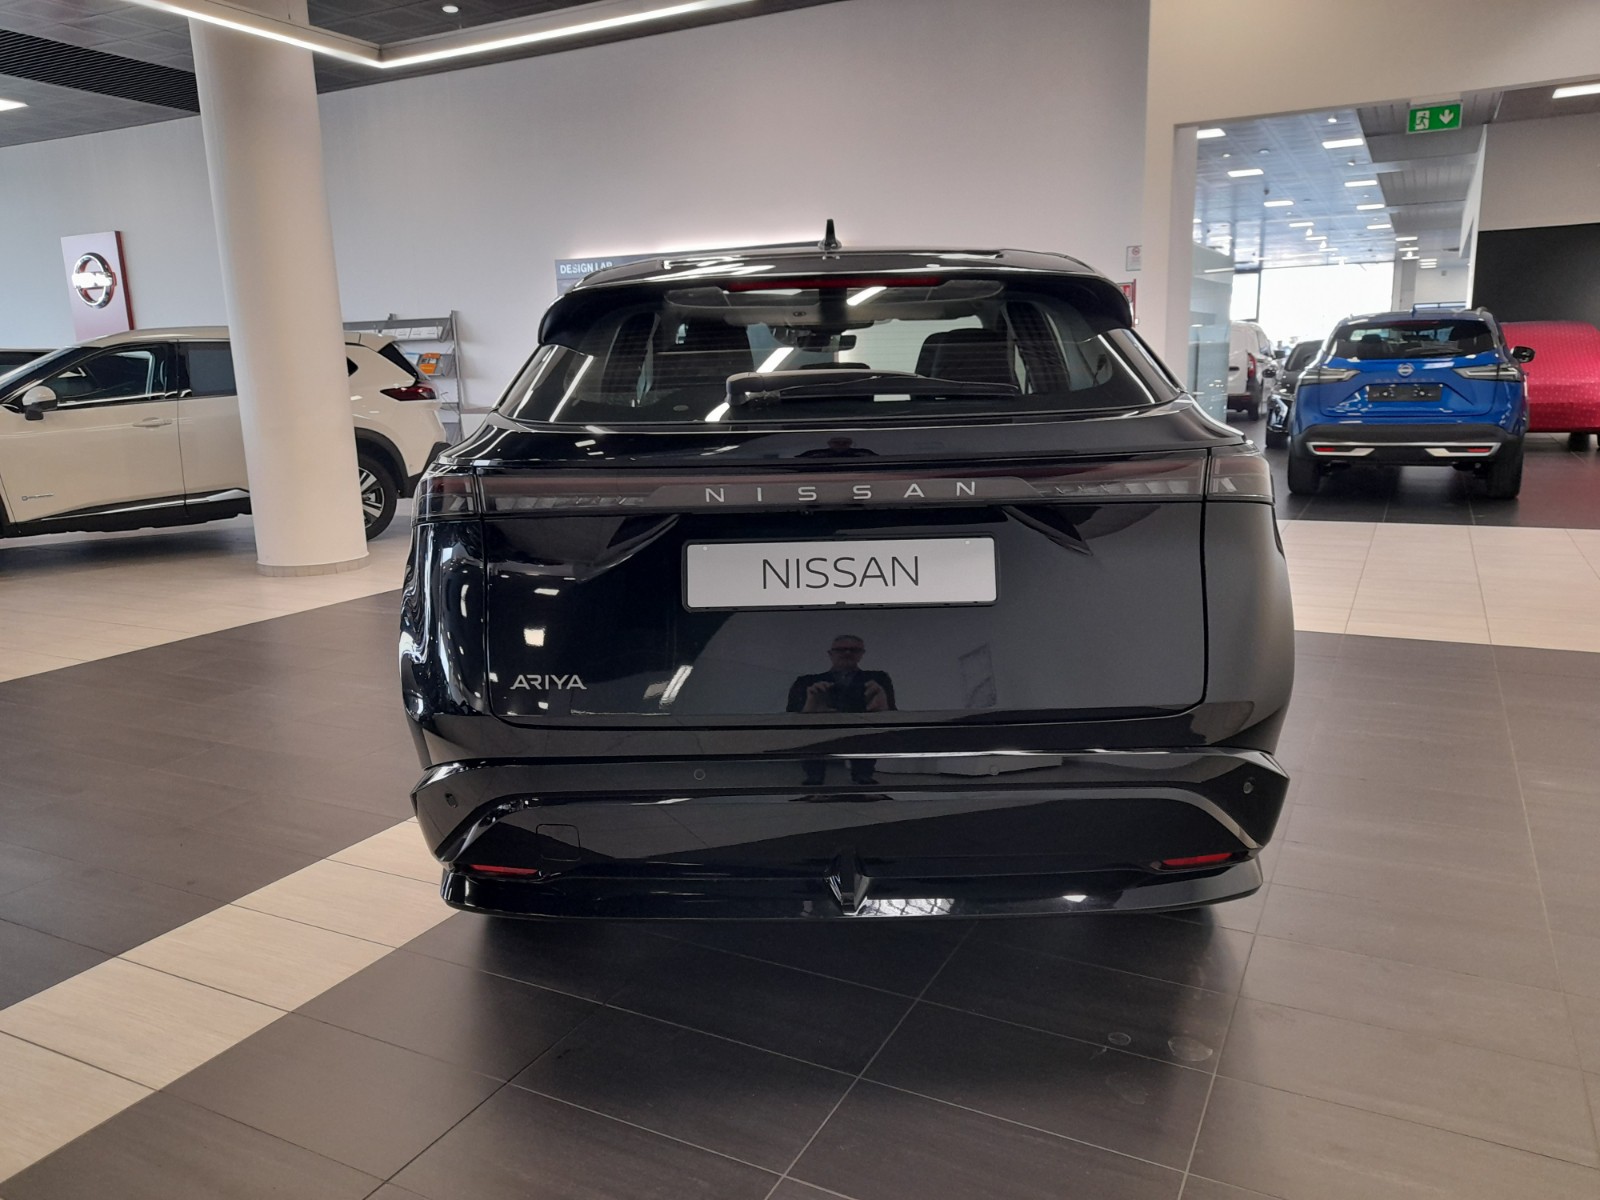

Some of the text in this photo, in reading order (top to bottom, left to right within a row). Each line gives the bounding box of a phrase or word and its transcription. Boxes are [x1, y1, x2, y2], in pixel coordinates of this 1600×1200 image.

[560, 262, 594, 274] DESIGN
[705, 481, 976, 503] NISSAN
[762, 555, 919, 590] NISSAN
[509, 674, 588, 690] ARIYA
